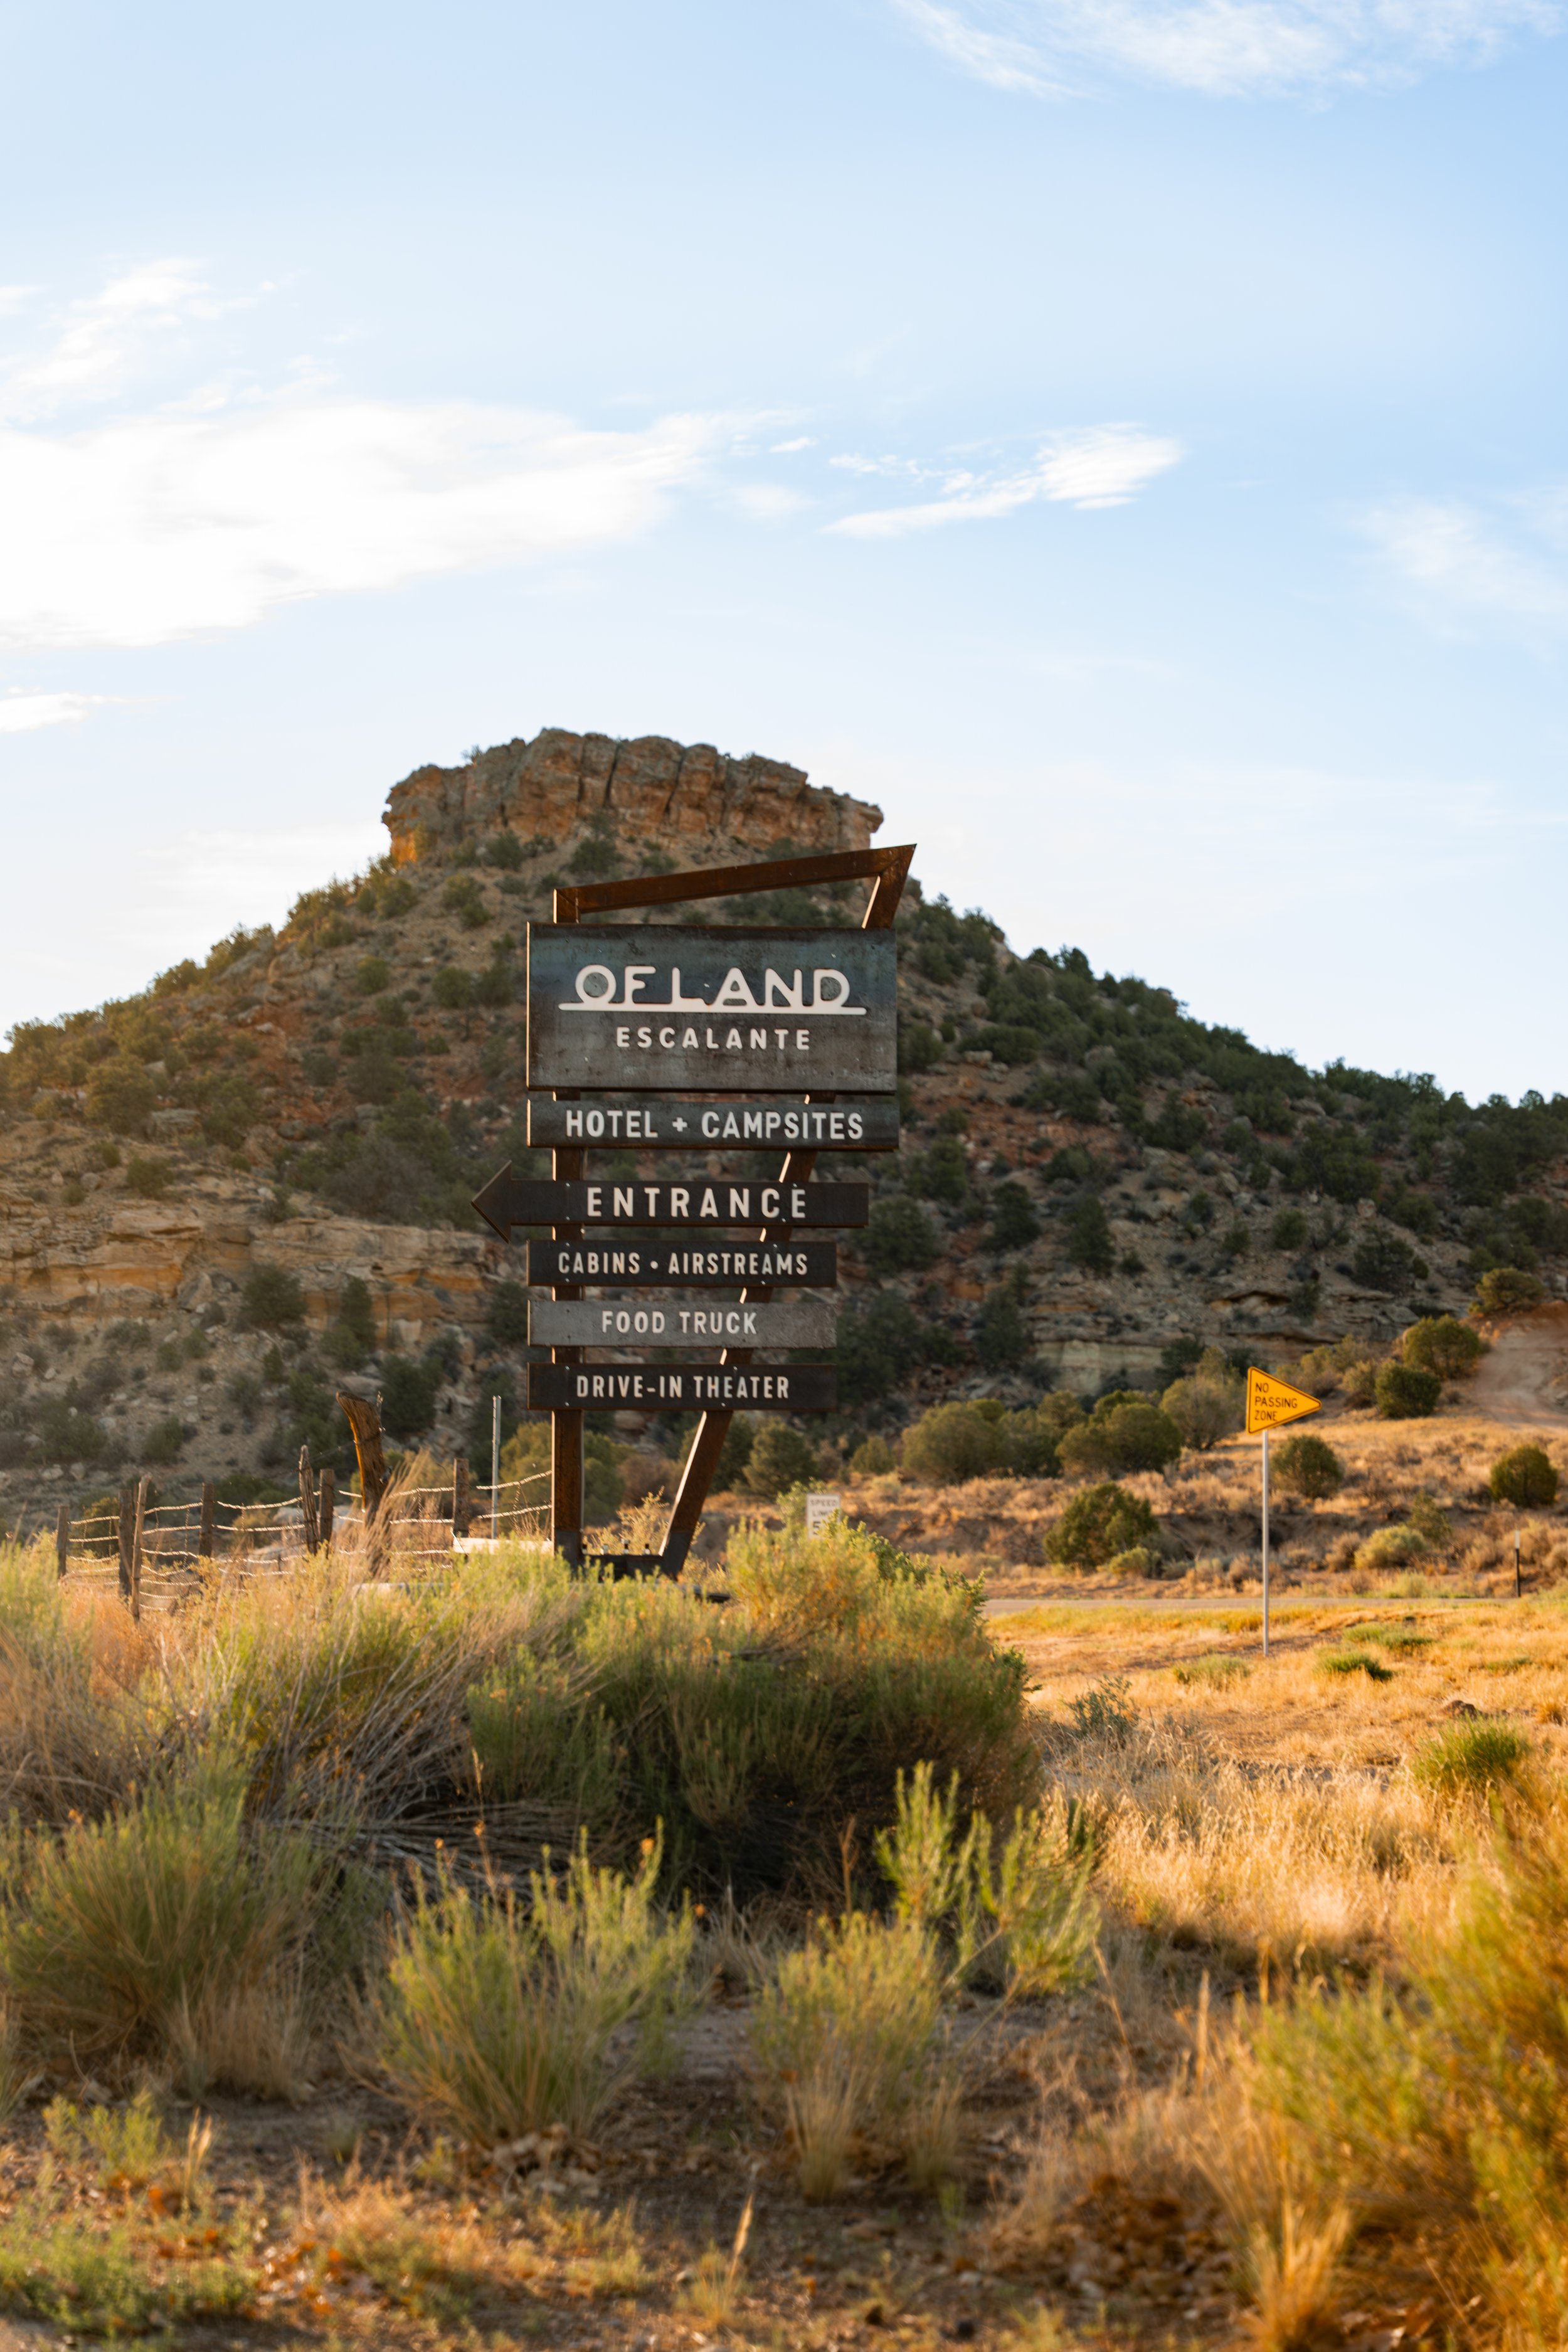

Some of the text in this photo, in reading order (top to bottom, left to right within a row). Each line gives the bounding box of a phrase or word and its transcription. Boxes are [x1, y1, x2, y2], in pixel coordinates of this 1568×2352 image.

[616, 1027, 810, 1051] ESCALANTE
[566, 1110, 658, 1138] HOTEL
[701, 1111, 863, 1140] CAMPSITES
[587, 1187, 806, 1218] ENTRANCE
[559, 1252, 640, 1274] CABINS
[668, 1253, 807, 1275] AIRSTREAMS
[602, 1311, 757, 1334] FOOD TRUCK
[577, 1375, 789, 1399] DRIVE-IN THEATER
[1255, 1382, 1269, 1393] NO
[1254, 1396, 1298, 1409] PASSING
[1254, 1410, 1277, 1421] ZONE
